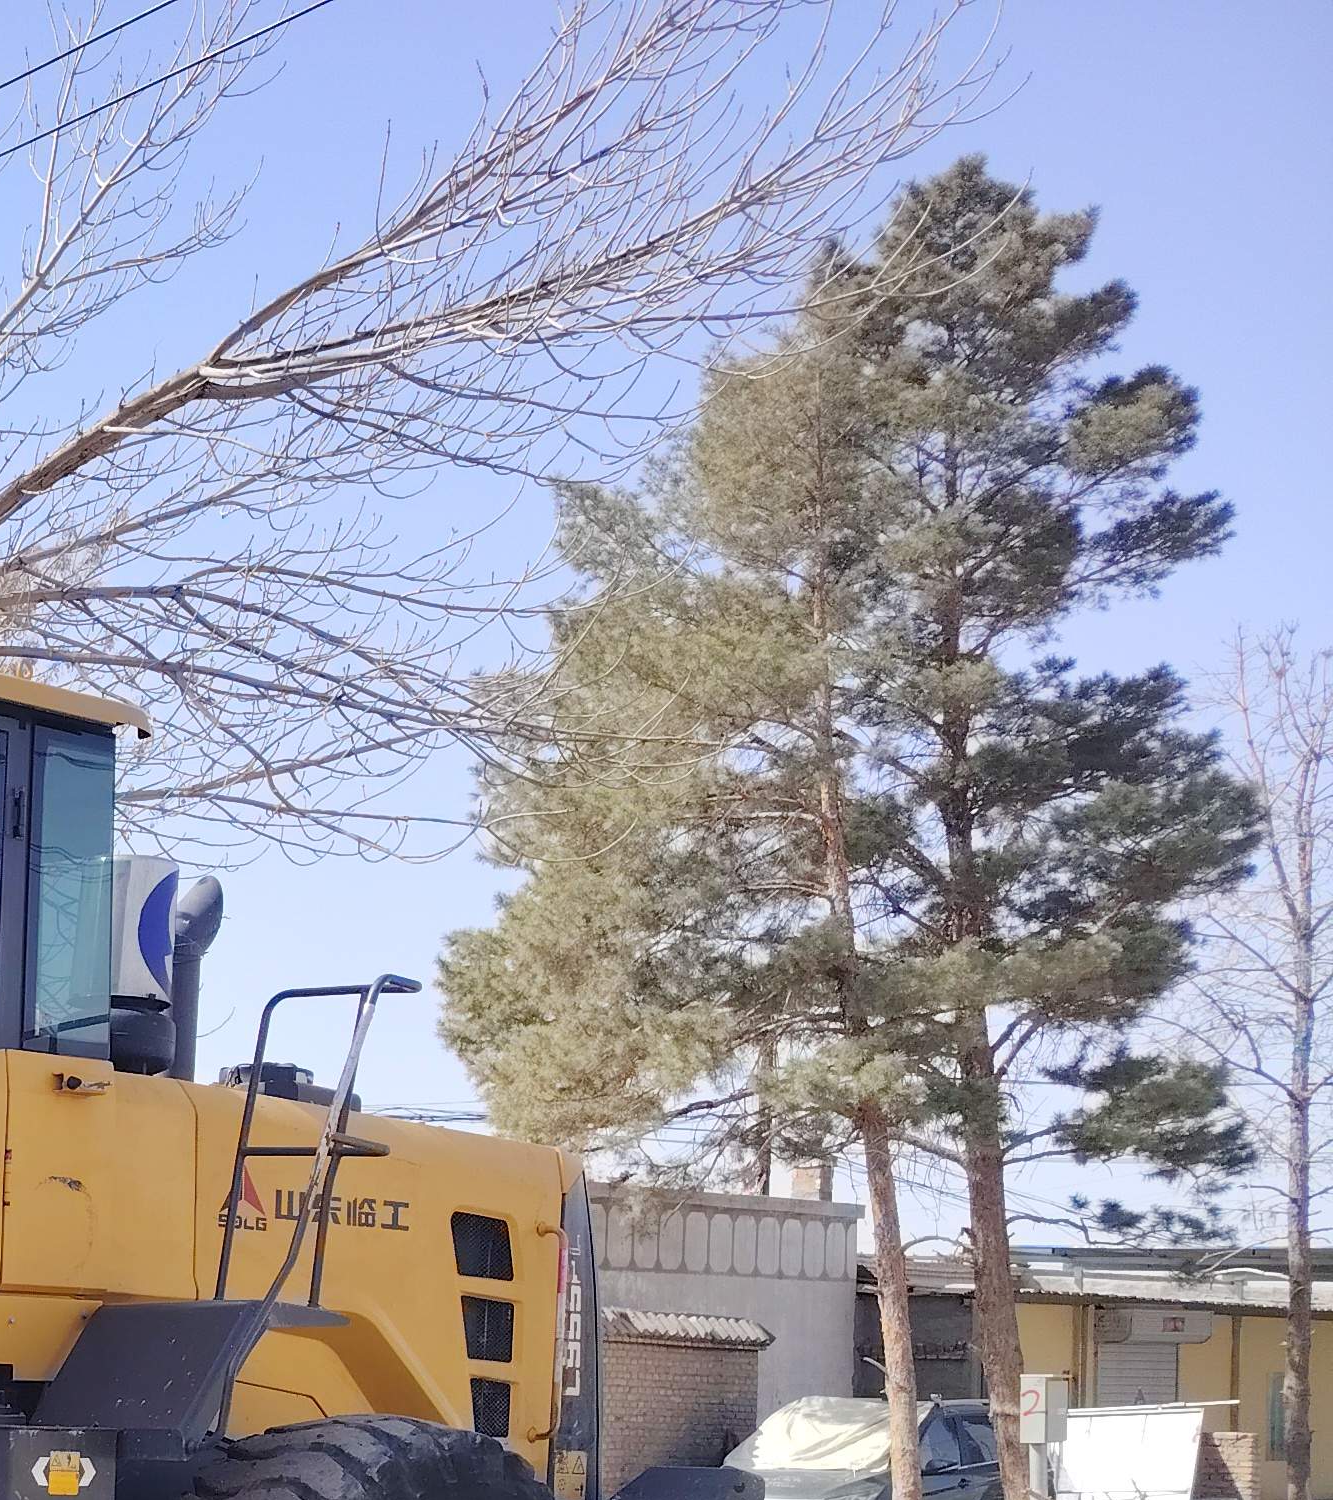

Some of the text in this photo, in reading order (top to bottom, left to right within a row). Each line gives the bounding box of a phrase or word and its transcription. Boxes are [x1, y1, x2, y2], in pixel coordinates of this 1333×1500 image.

[218, 1213, 268, 1232] SDLG
[274, 1188, 410, 1232] 山东临工
[1021, 1389, 1041, 1417] 2
